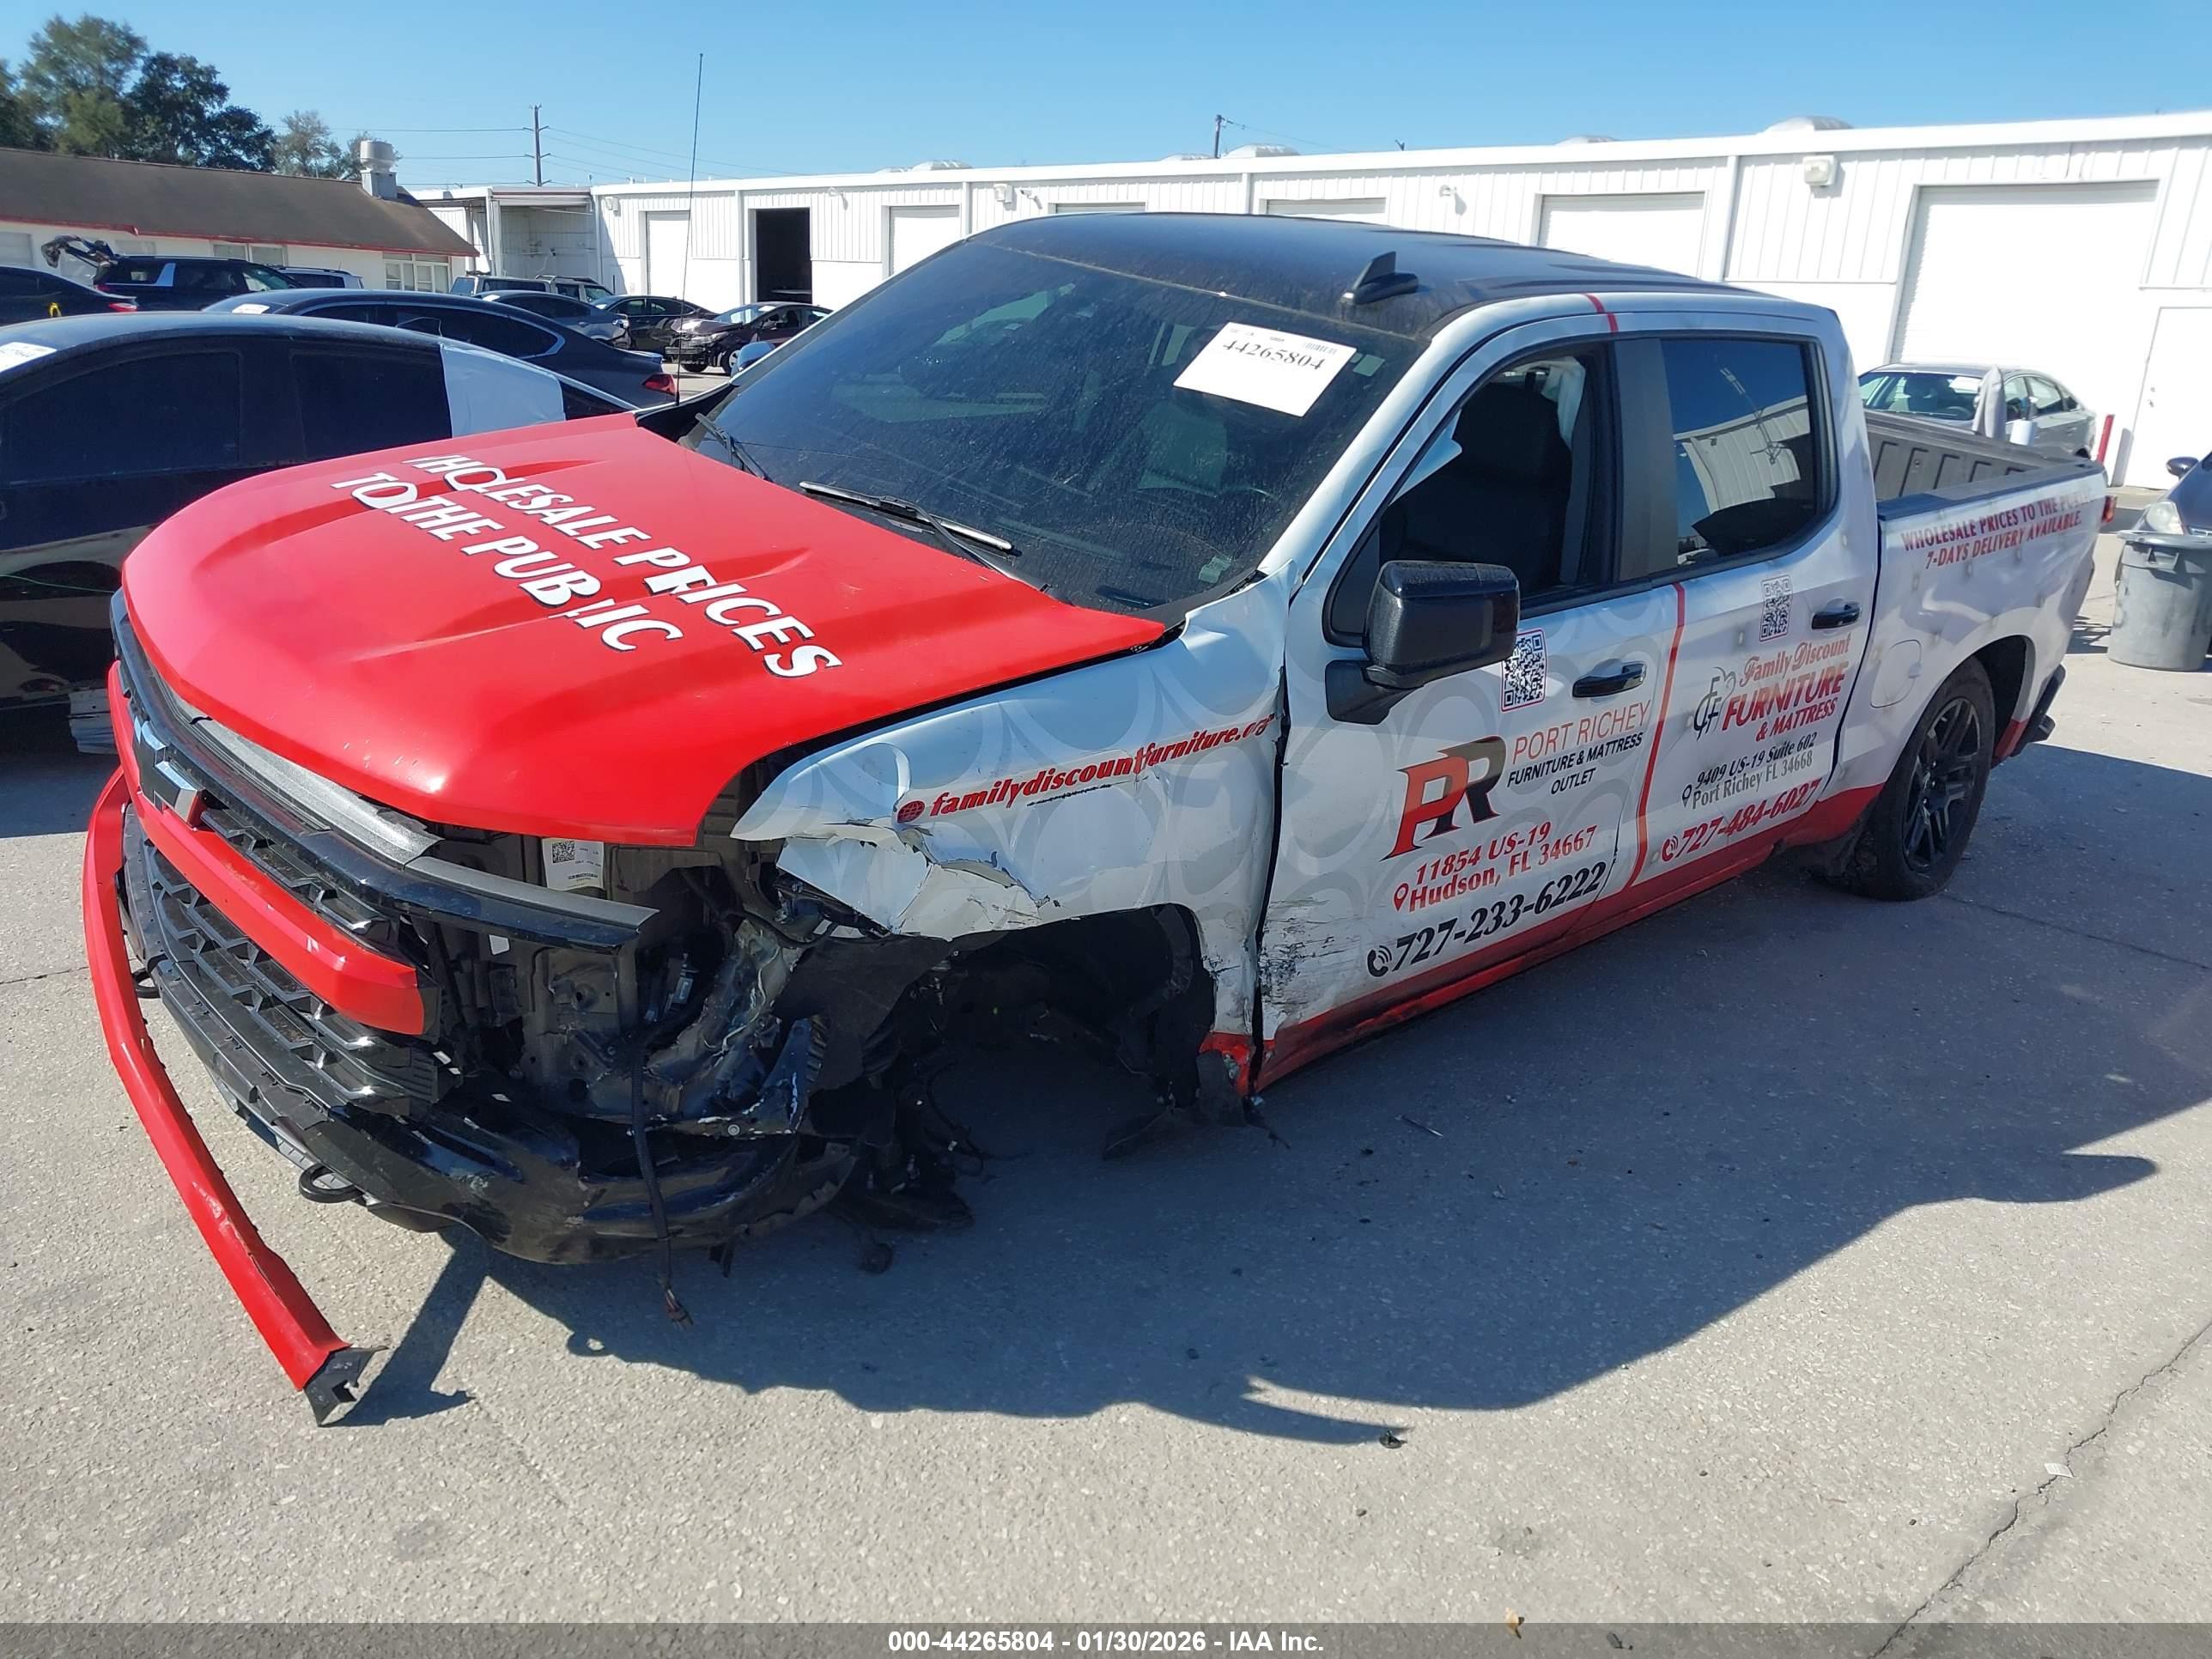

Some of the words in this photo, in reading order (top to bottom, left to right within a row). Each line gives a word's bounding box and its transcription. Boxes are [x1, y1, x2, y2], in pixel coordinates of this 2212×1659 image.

[1223, 339, 1326, 370] 44265804
[330, 472, 418, 510] TO
[384, 495, 507, 542] THE
[1900, 520, 1978, 552] WHOLESALE
[1979, 508, 2019, 534] PRICES
[2020, 503, 2036, 522] TO
[2038, 497, 2058, 517] THE
[1925, 542, 1970, 570] 7-DAYS
[1972, 526, 2027, 558] DELIVERY
[613, 546, 842, 678] PRICES
[1739, 650, 1793, 688] Family
[1791, 632, 1851, 672] Discount
[1722, 660, 1850, 732] FURNITURE
[1755, 721, 1768, 742] &
[1769, 697, 1838, 737] MATTRESS
[1507, 752, 1577, 788] FURNITURE
[1576, 750, 1586, 767] &
[1586, 732, 1644, 763] MATTRESS
[1511, 722, 1573, 765] PORT
[1576, 699, 1651, 747] RICHEY
[1695, 763, 1728, 789] 9409
[1729, 750, 1765, 777] US-19
[1766, 740, 1795, 763] Suite
[1796, 731, 1818, 752] 602
[1551, 768, 1597, 795] OUTLET
[1692, 783, 1721, 810] Port
[1723, 772, 1764, 793] Richey
[1765, 764, 1778, 783] FL
[1781, 749, 1814, 777] 34668
[1675, 777, 1823, 859] 727-484-6027
[1408, 866, 1501, 912] Hudson,
[1509, 851, 1532, 877] FL
[1537, 824, 1598, 866] 34667
[1416, 845, 1482, 885] 11854
[1487, 821, 1552, 860] US-19
[1393, 860, 1607, 972] 727-233-6222
